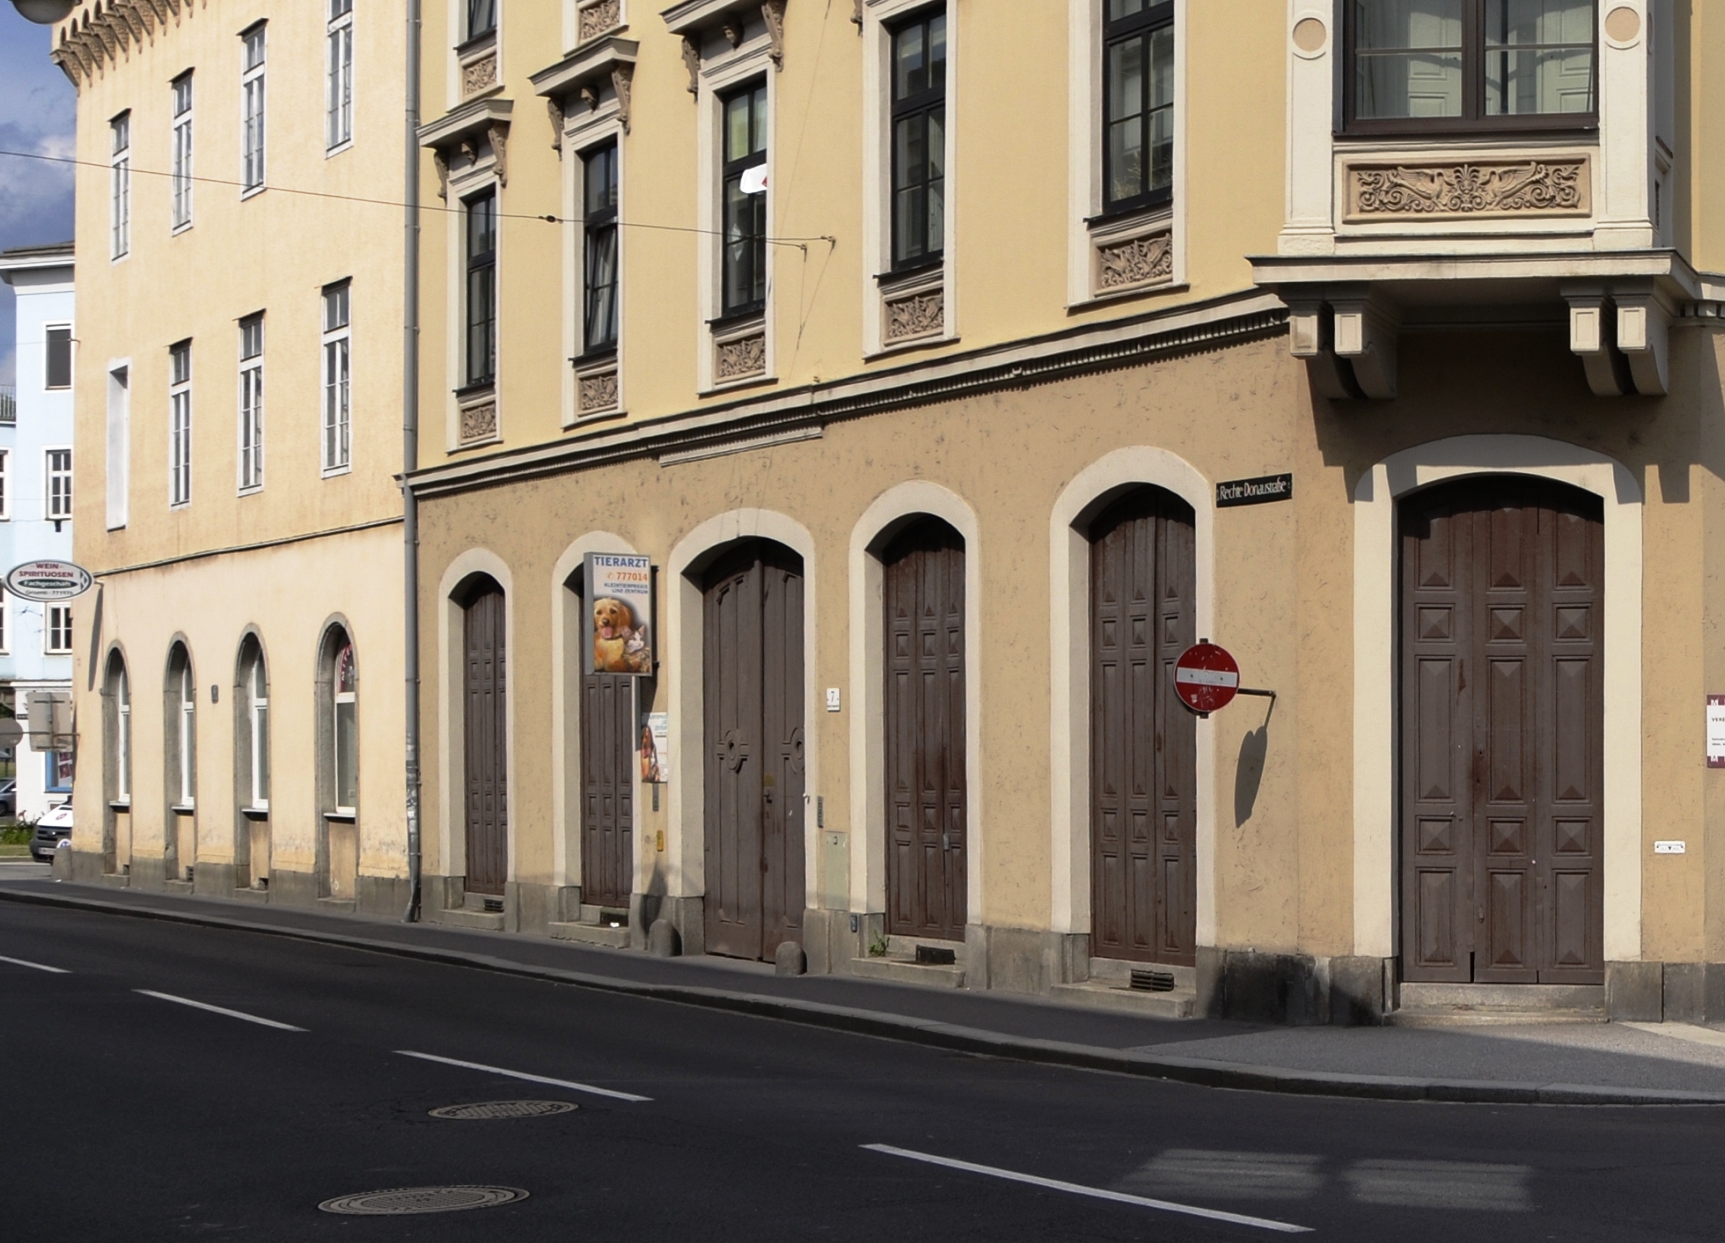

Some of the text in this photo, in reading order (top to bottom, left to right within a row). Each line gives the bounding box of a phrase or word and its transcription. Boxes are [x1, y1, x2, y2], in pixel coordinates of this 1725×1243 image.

[1220, 477, 1287, 500] Rechte Donaustraße
[594, 557, 648, 568] TIERARZT
[616, 572, 648, 581] 777014
